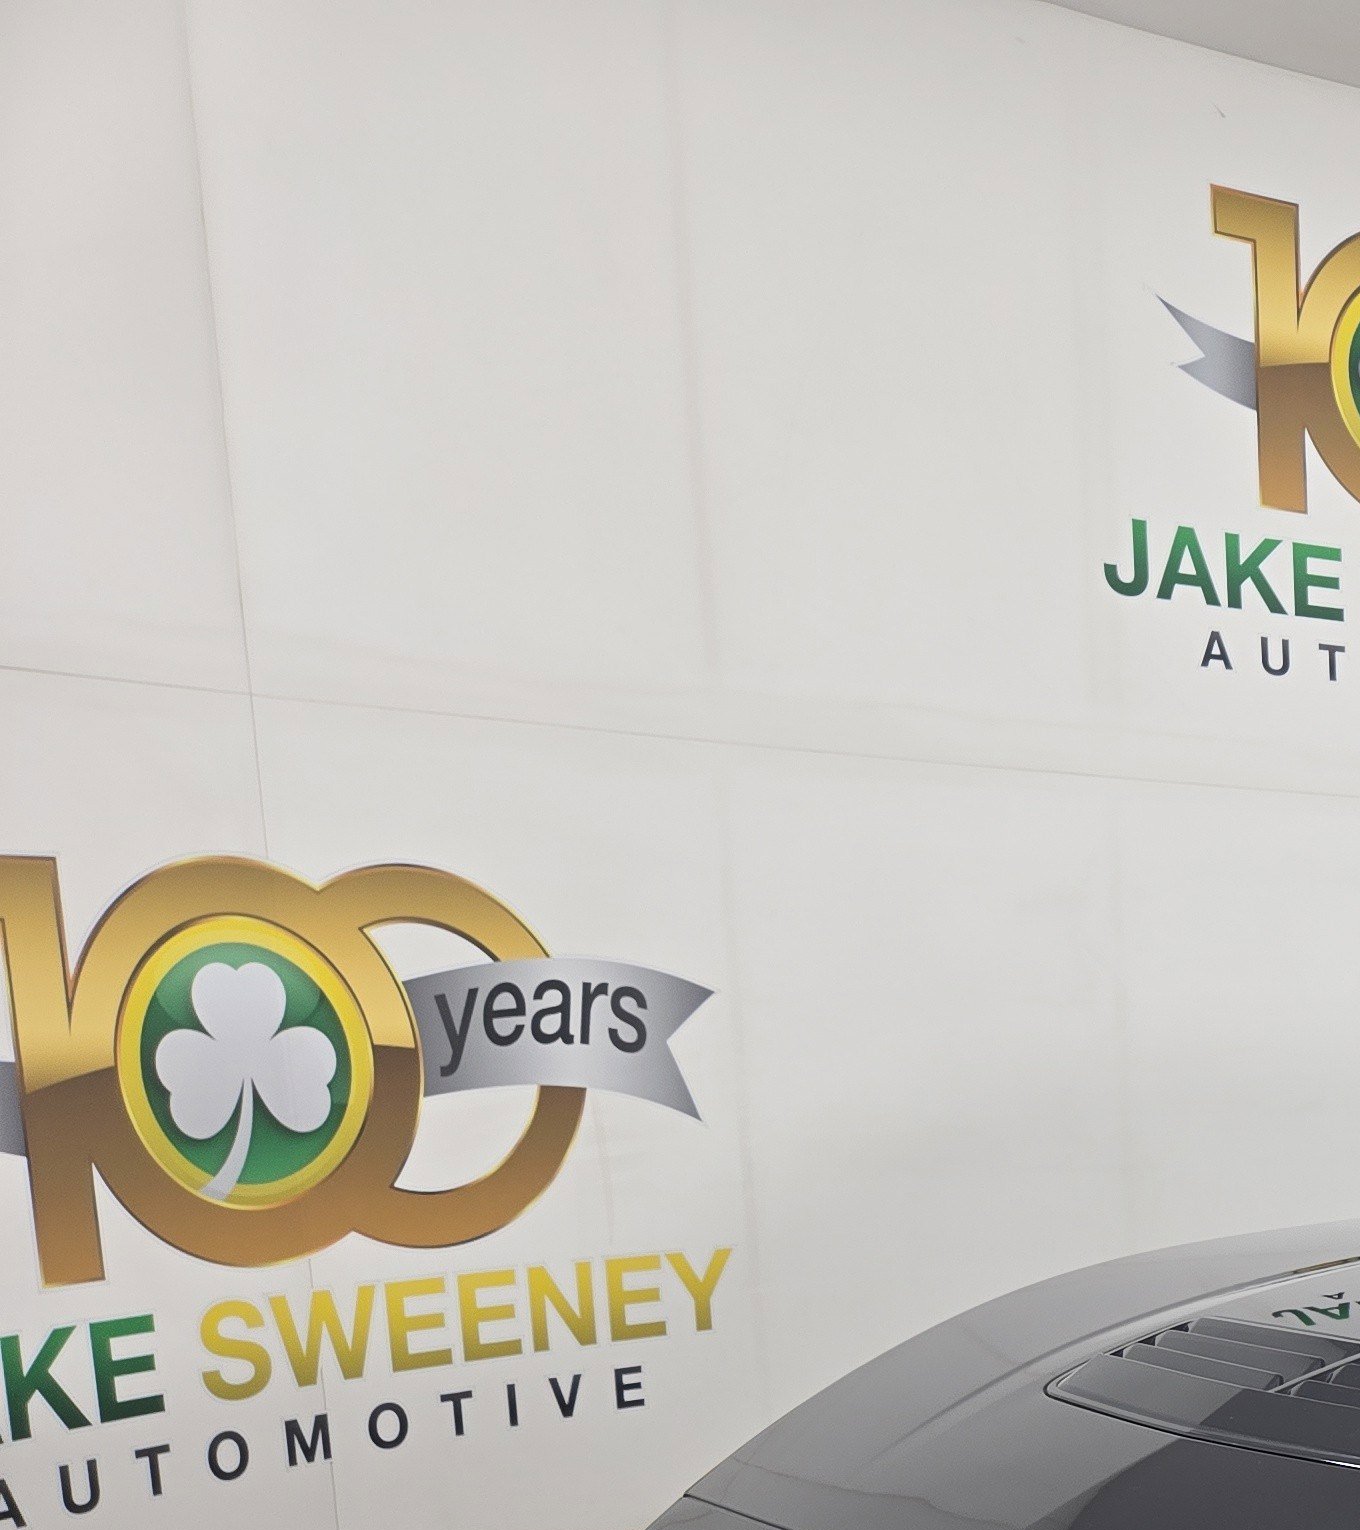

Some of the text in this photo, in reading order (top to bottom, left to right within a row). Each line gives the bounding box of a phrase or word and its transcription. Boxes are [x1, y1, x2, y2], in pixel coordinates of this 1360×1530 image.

[1103, 517, 1346, 623] JAKE
[434, 977, 649, 1078] years
[0, 1248, 732, 1444] KE SWEENEY
